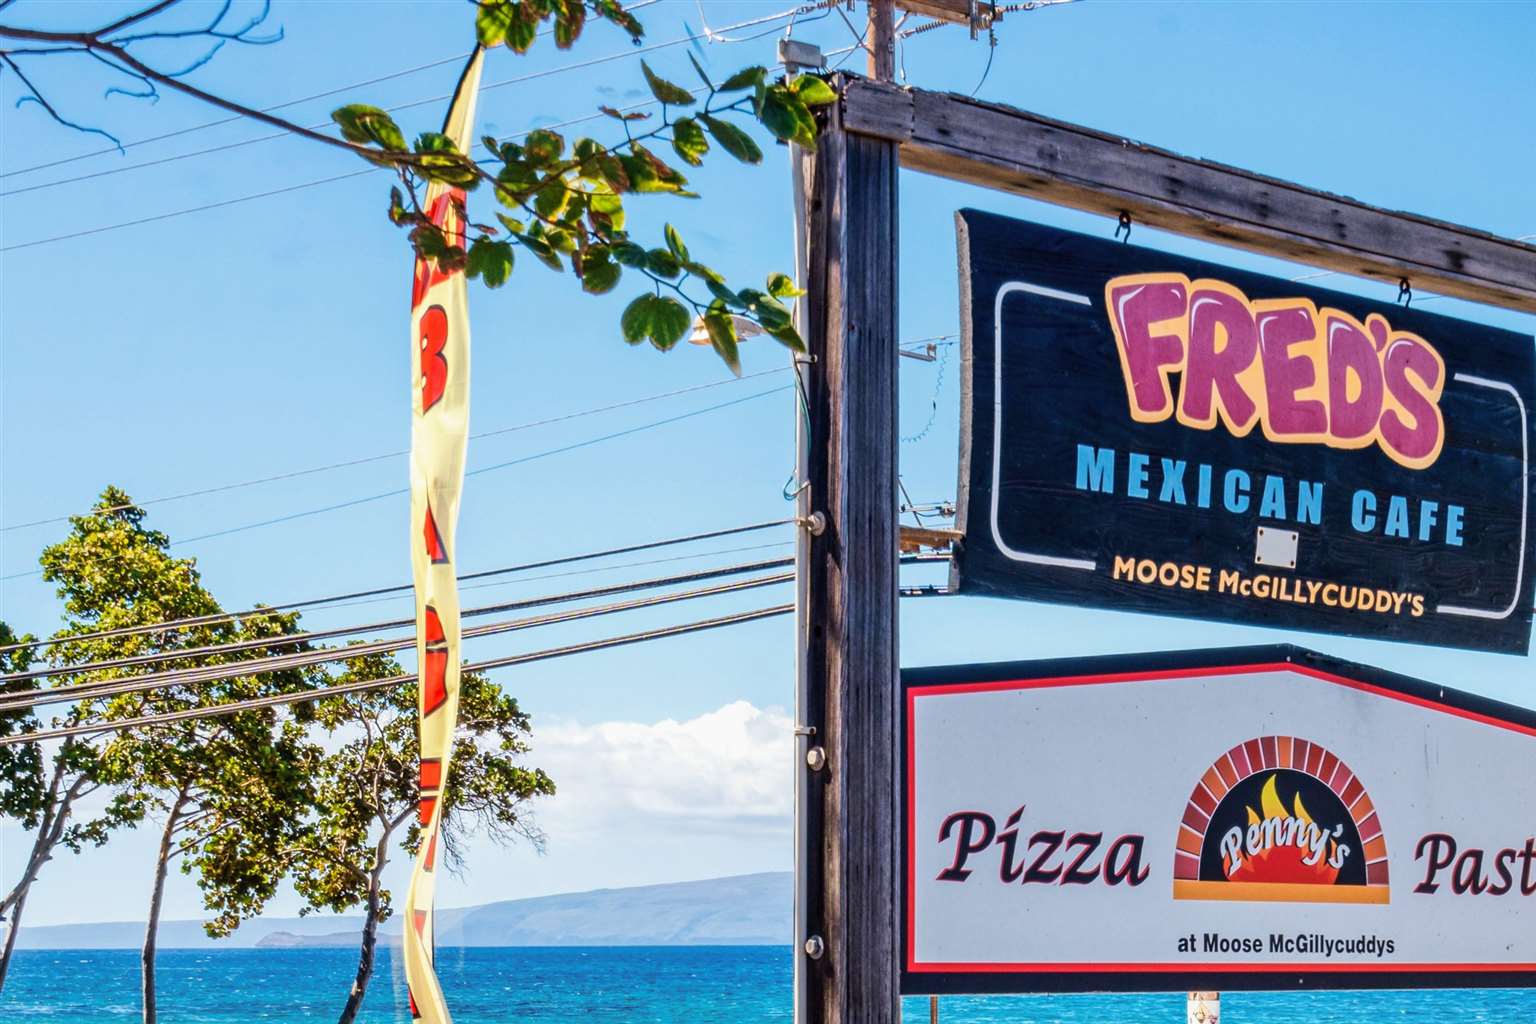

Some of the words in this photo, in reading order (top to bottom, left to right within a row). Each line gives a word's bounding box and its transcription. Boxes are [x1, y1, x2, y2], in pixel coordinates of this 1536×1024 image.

[1105, 273, 1445, 469] FRED'S
[1076, 444, 1323, 525] MEXICAN
[1351, 490, 1464, 546] CAFE
[1113, 556, 1210, 592] MOOSE
[1218, 570, 1424, 617] McGILLYCUDDY'S
[1220, 816, 1350, 877] Penny's
[1178, 934, 1196, 953] at
[1203, 933, 1263, 953] Moose
[1269, 934, 1395, 957] McGillycuddys
